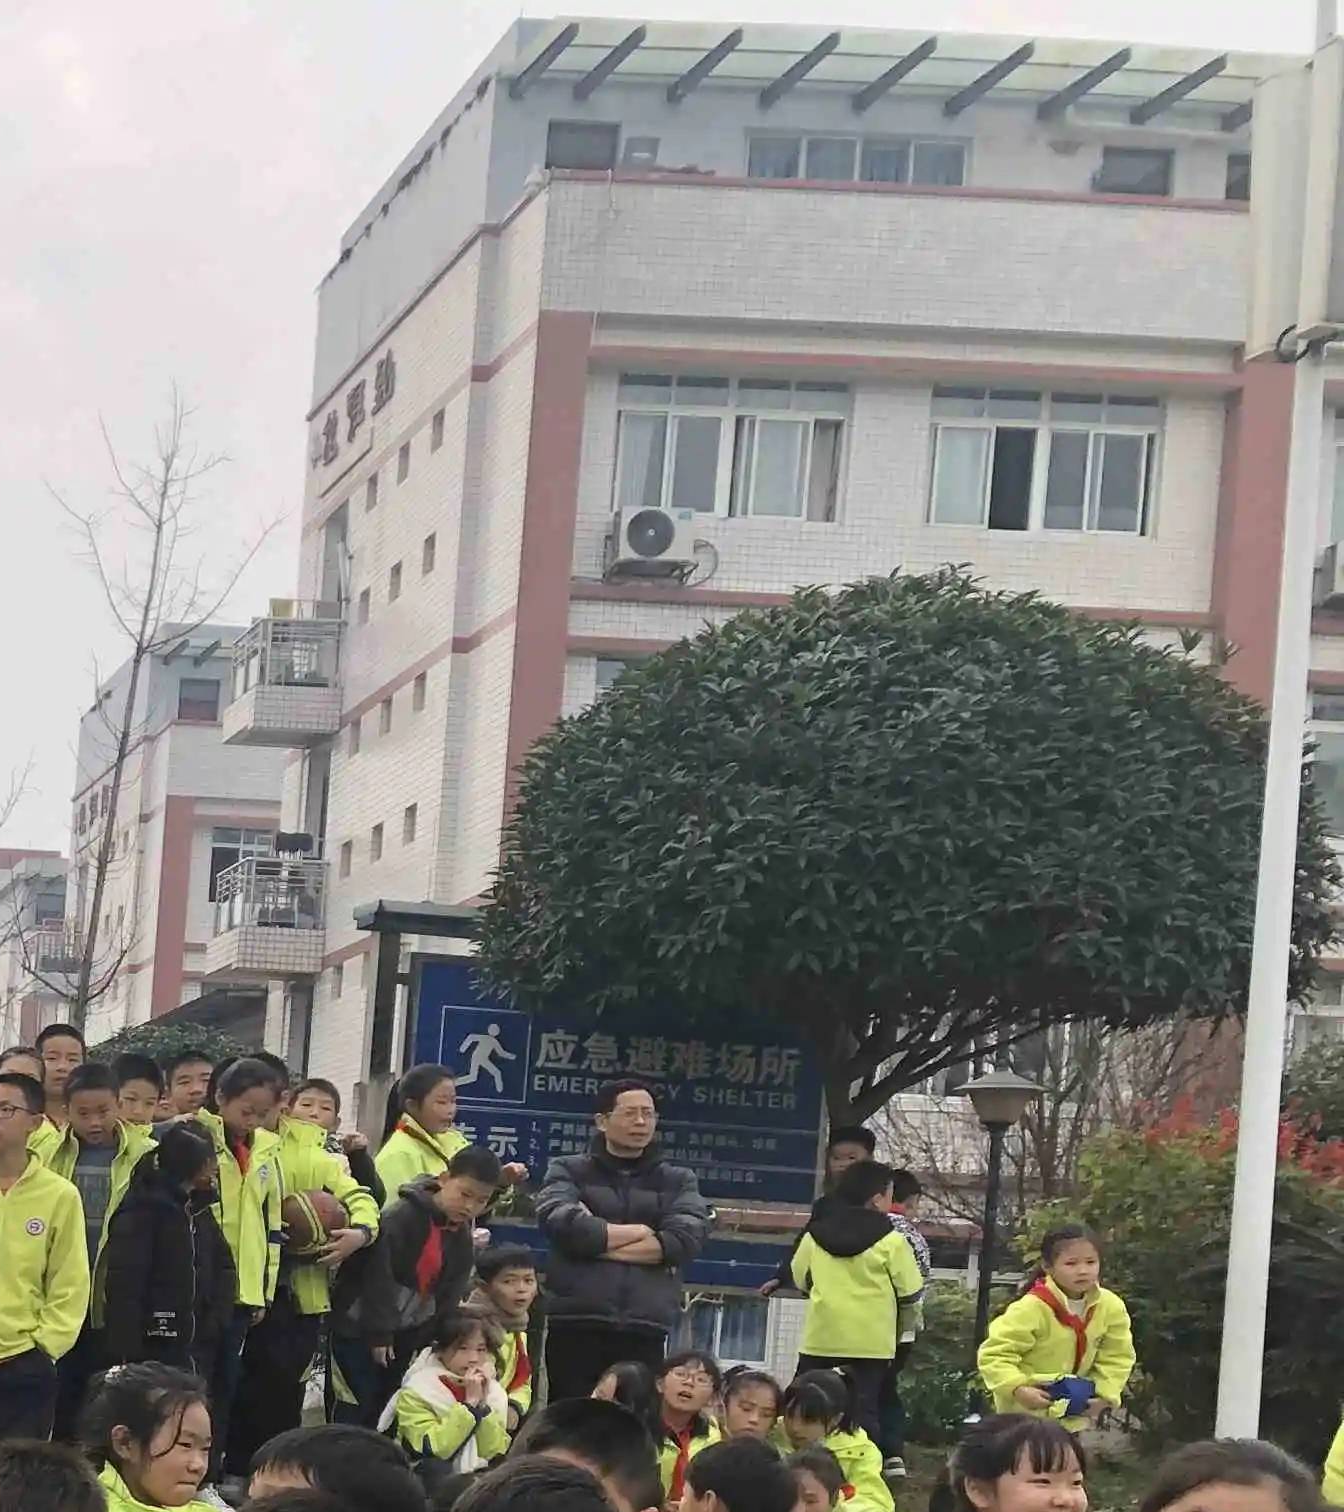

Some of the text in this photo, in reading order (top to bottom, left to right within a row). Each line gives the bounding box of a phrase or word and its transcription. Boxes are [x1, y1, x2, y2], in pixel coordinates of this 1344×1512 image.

[535, 1029, 802, 1087] 应急避难场所
[693, 1086, 796, 1110] SHELTER
